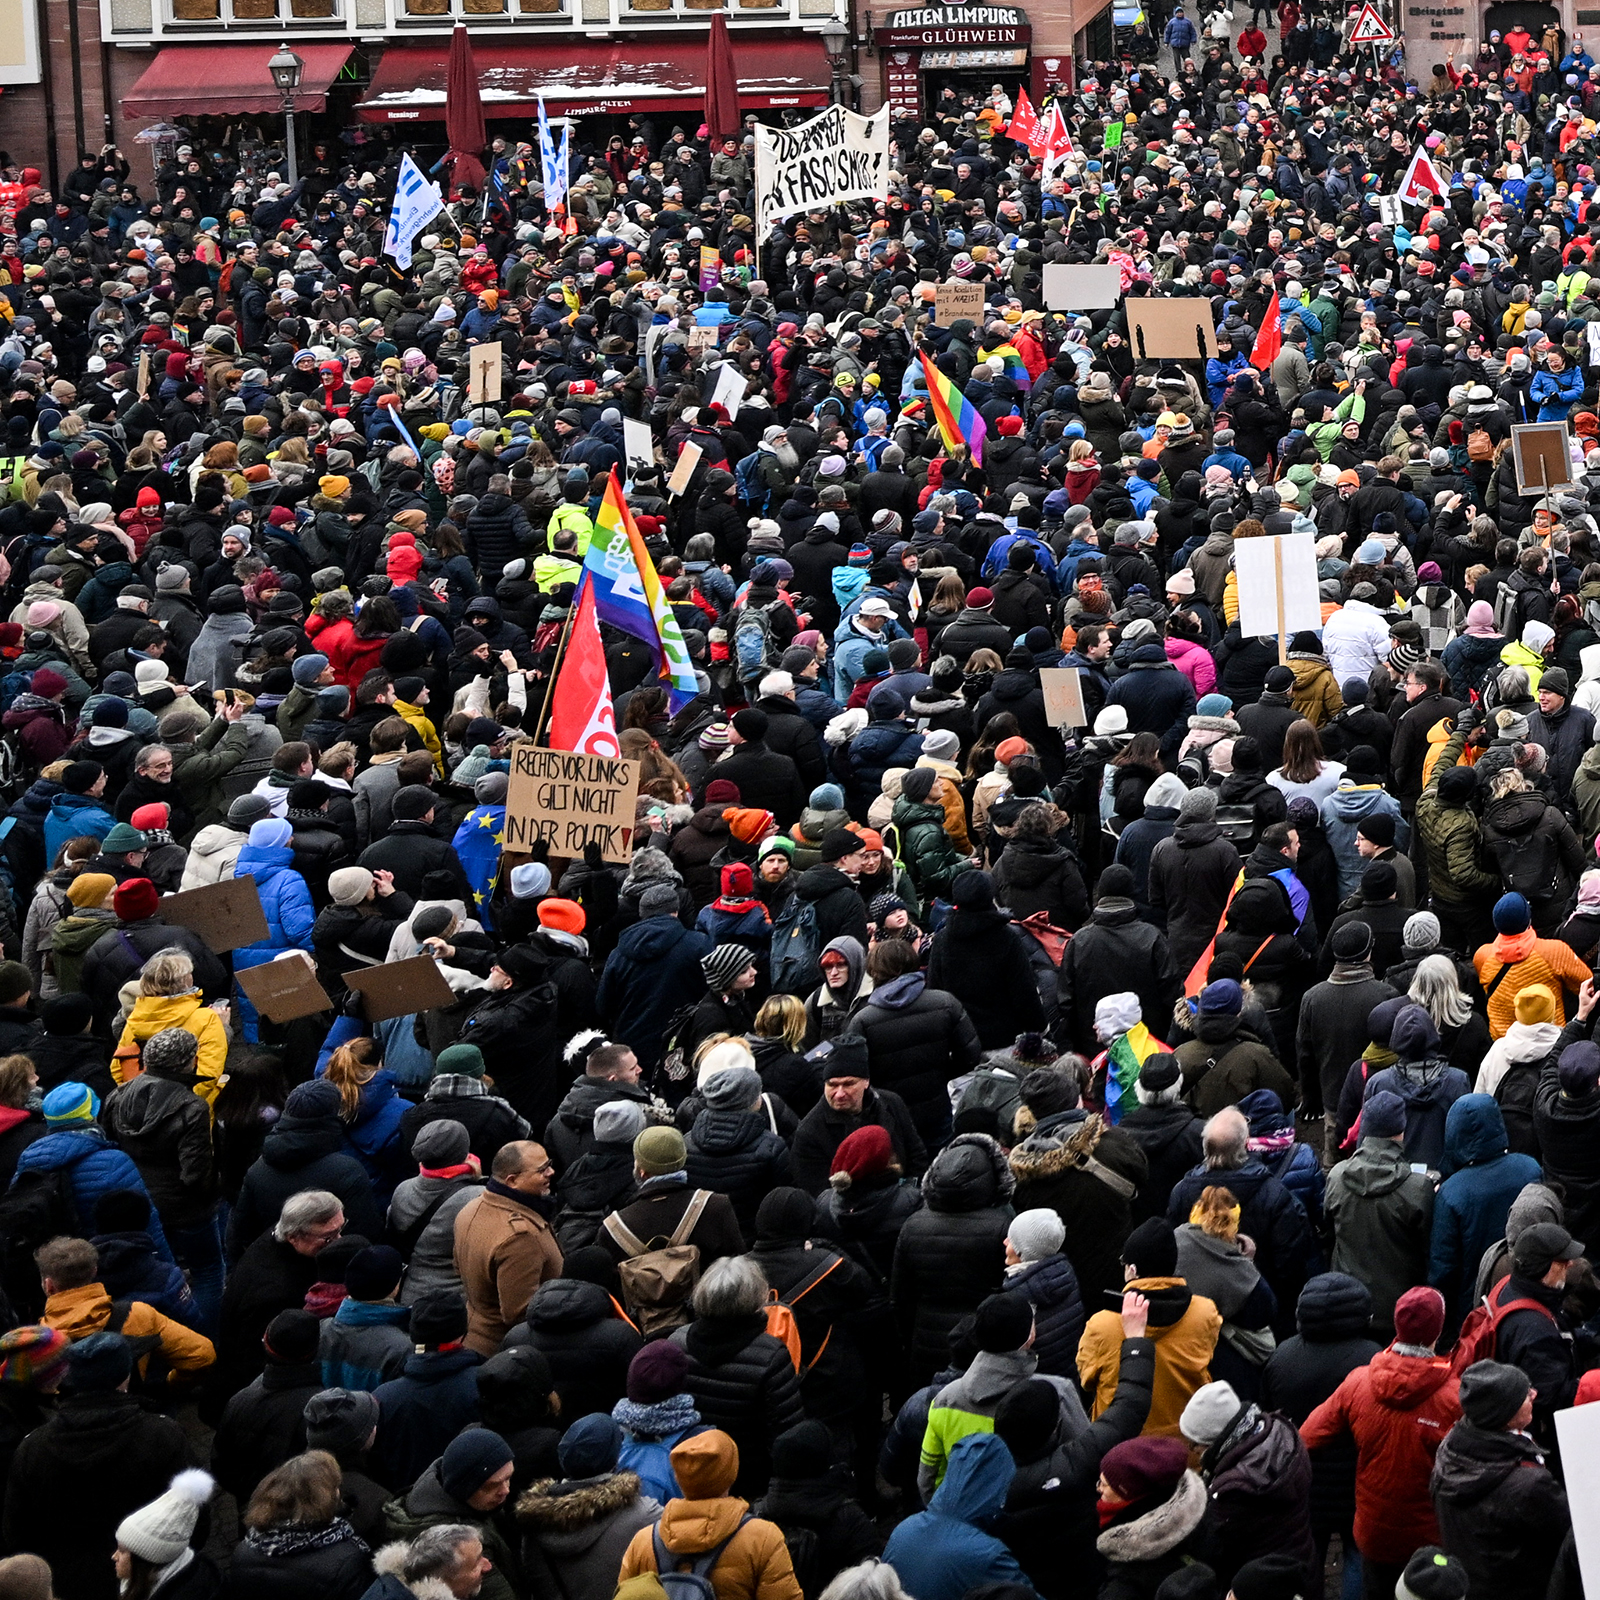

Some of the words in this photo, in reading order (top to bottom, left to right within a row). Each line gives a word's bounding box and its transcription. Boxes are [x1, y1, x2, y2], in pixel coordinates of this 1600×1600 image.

[893, 10, 944, 27] ALTEN
[947, 7, 1018, 26] LIMPURG
[921, 29, 1017, 44] GLÜHWEIN
[515, 749, 560, 780] RECHTS
[560, 753, 587, 782] VOR
[586, 758, 631, 786] LINKS
[537, 783, 570, 811] GILT
[573, 786, 622, 815] NICHT
[506, 815, 526, 844] IN
[528, 818, 560, 851] DER
